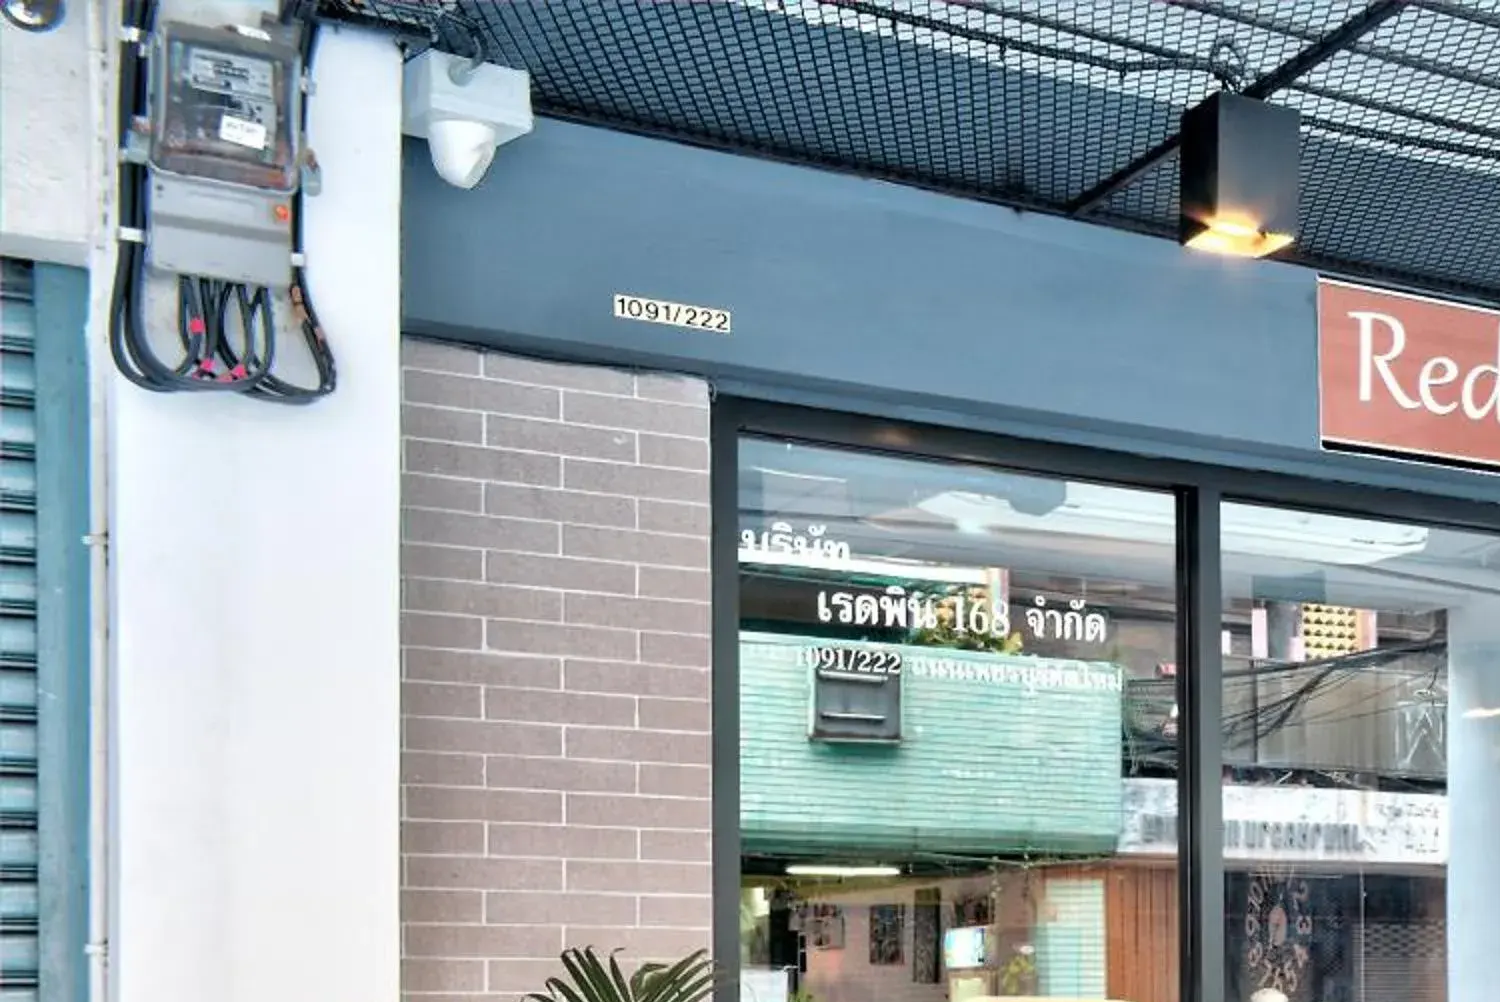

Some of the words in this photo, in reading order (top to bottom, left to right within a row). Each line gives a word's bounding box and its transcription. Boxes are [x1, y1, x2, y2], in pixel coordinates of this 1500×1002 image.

[617, 298, 729, 330] 1091/222
[816, 585, 938, 629] เรดพิน
[951, 594, 1010, 639] 168
[1025, 595, 1105, 642] จำกัด
[796, 647, 902, 676] 1091/222
